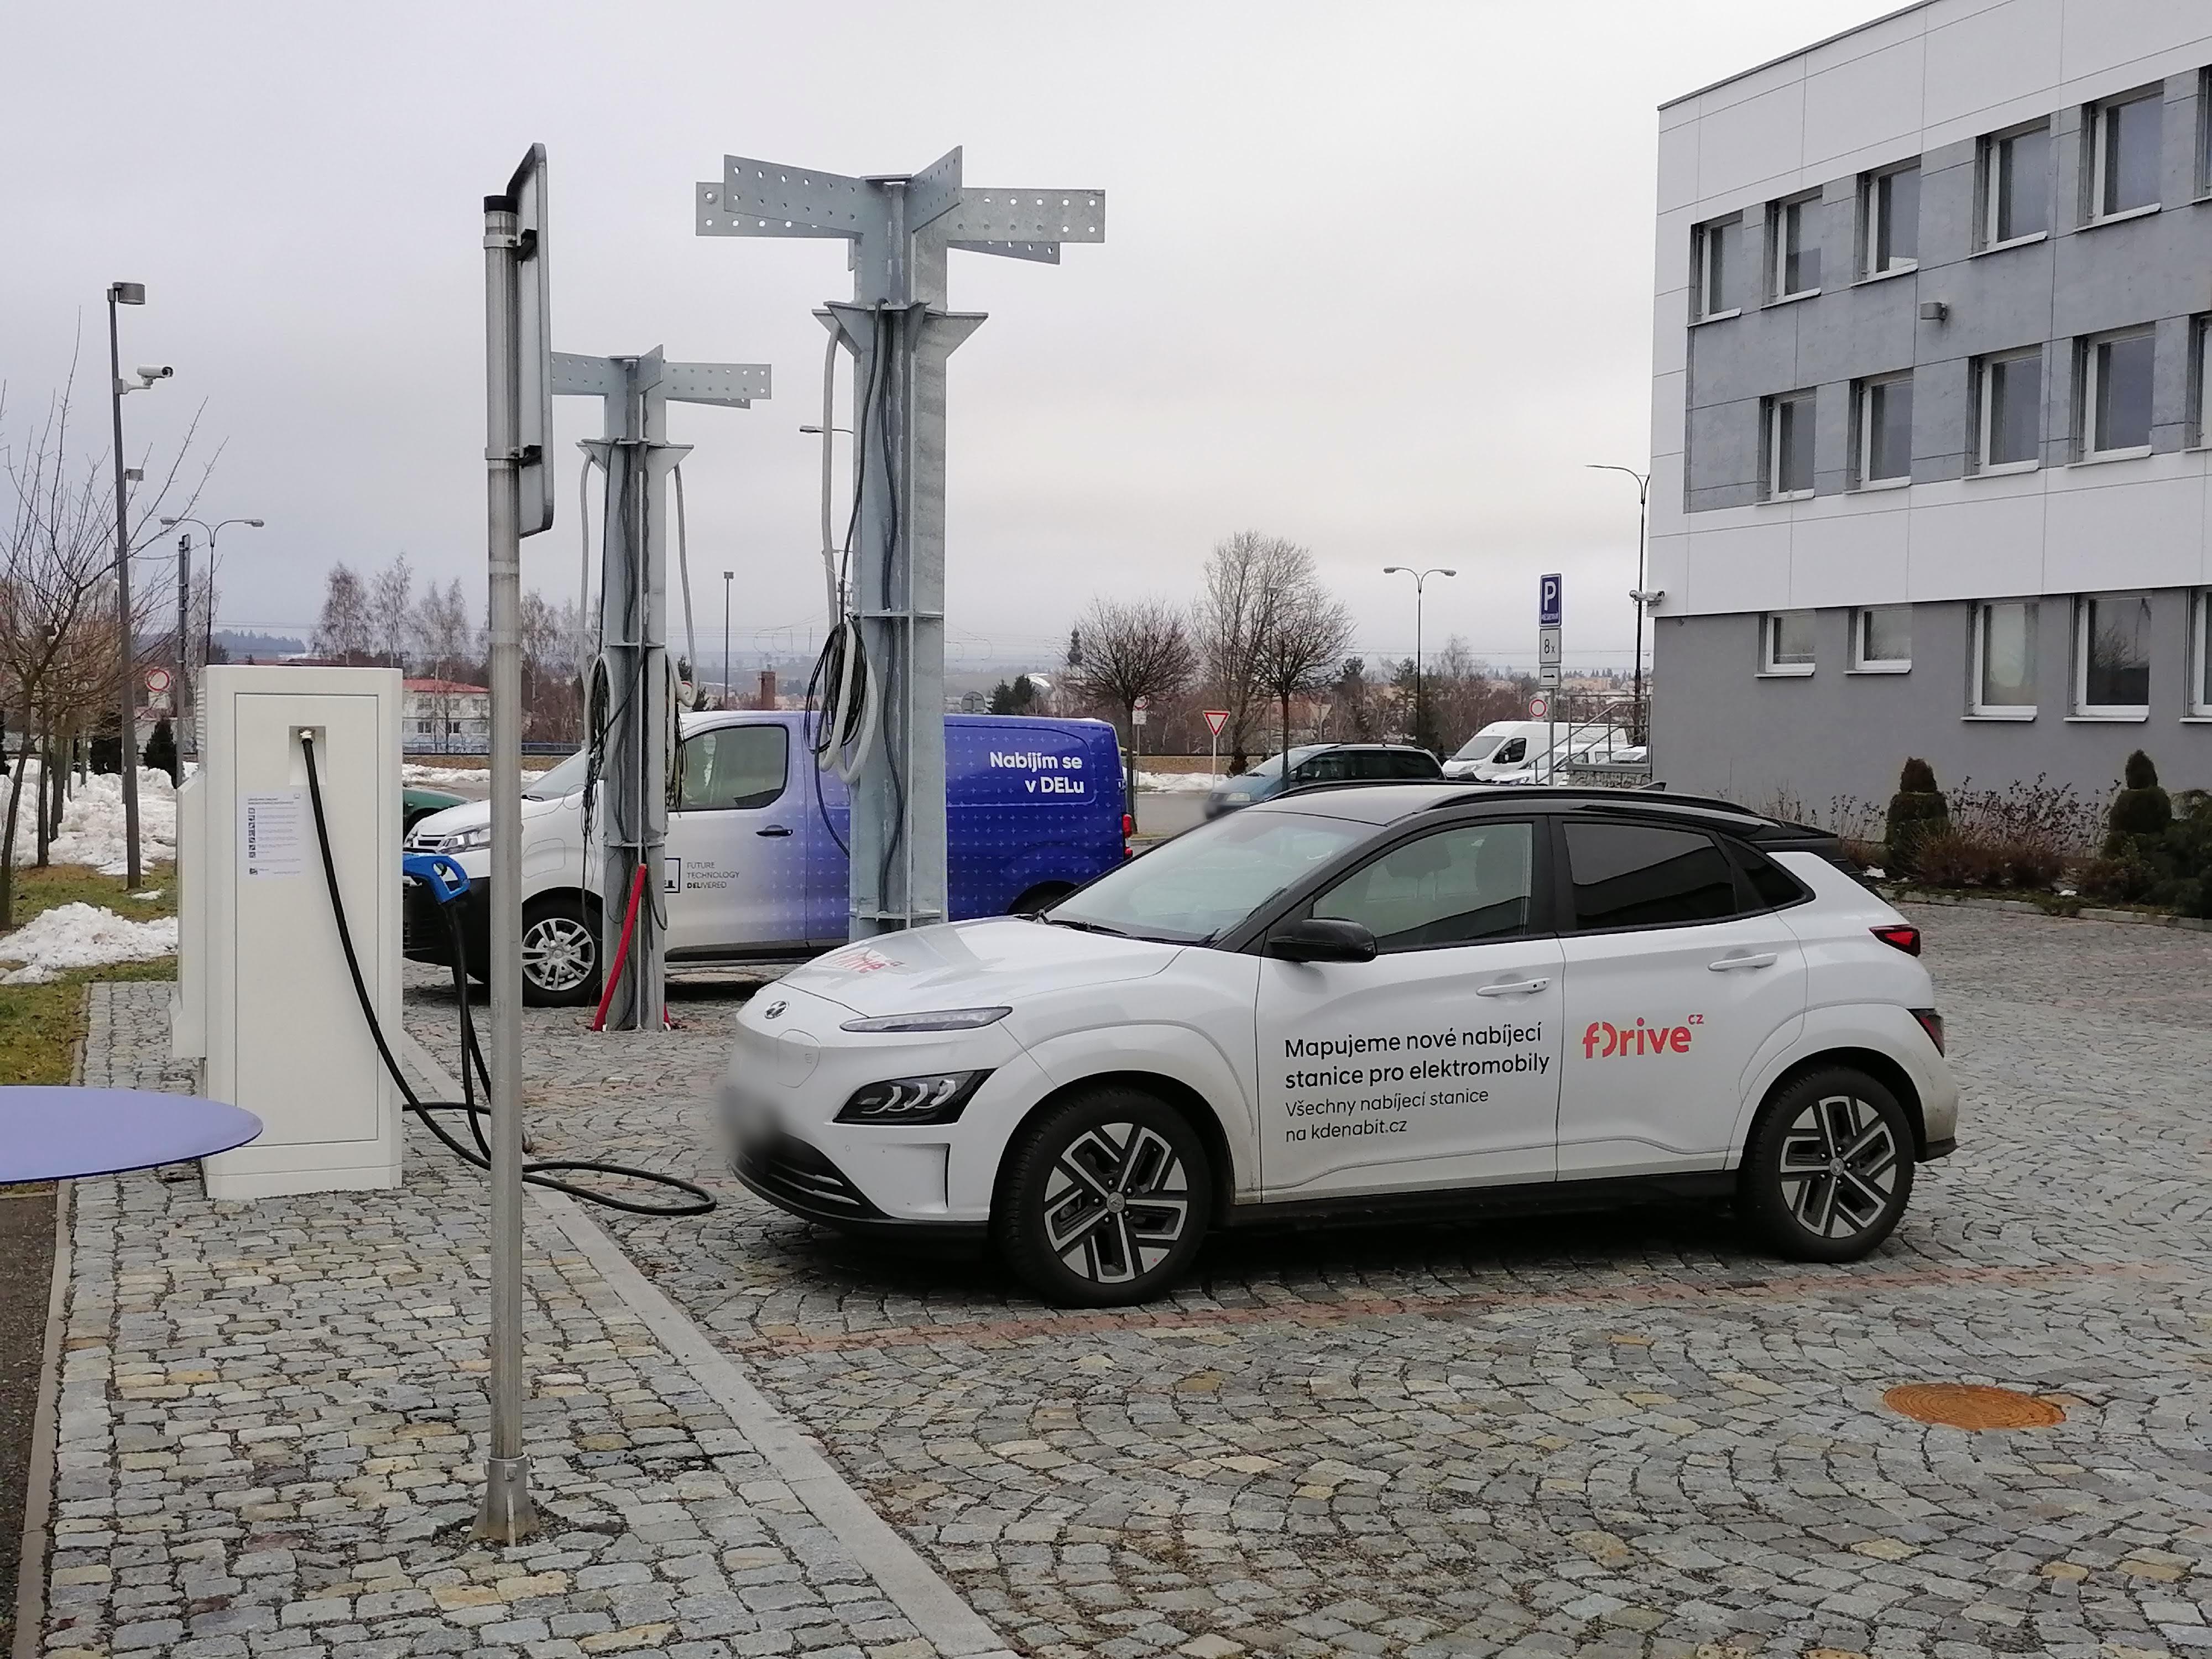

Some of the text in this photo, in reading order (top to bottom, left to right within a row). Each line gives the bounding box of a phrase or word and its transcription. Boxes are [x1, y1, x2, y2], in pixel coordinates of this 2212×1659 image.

[1544, 581, 1556, 611] P
[1062, 756, 1083, 769] se
[1025, 776, 1084, 794] v DELu
[687, 871, 740, 879] TECHNOLOGY
[1285, 1021, 1542, 1060] Mapujeme nové nabíjecí
[1285, 1052, 1550, 1089] stanice pro elektromobily
[1285, 1098, 1357, 1117] Všechny
[1430, 1091, 1489, 1106] stanice
[1286, 1118, 1407, 1142] na kdenabit.cz
